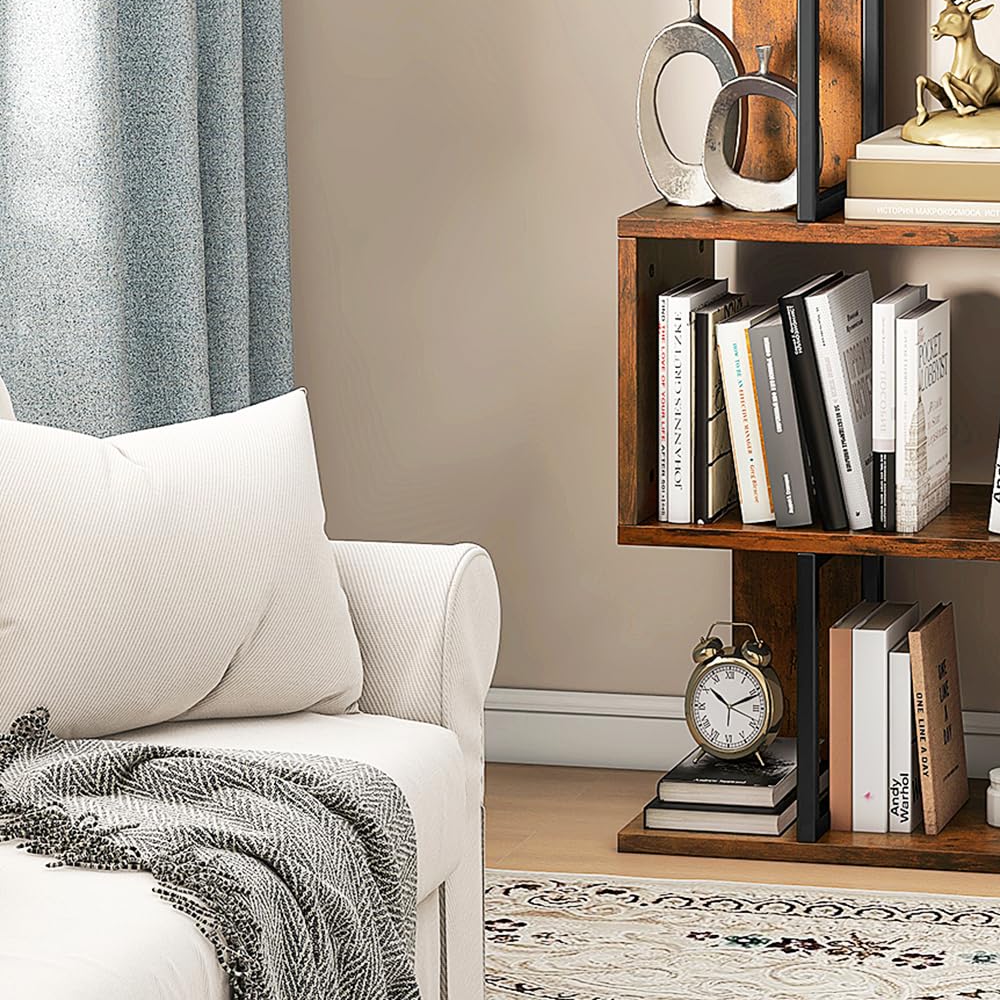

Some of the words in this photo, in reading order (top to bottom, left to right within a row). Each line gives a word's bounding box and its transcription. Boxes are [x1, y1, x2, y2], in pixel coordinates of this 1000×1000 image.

[674, 396, 682, 490] JOHANNES
[916, 692, 924, 713] ONE
[918, 718, 926, 742] LINE
[922, 756, 930, 777] DAY
[890, 778, 902, 816] Andy
[900, 773, 910, 823] Warhol
